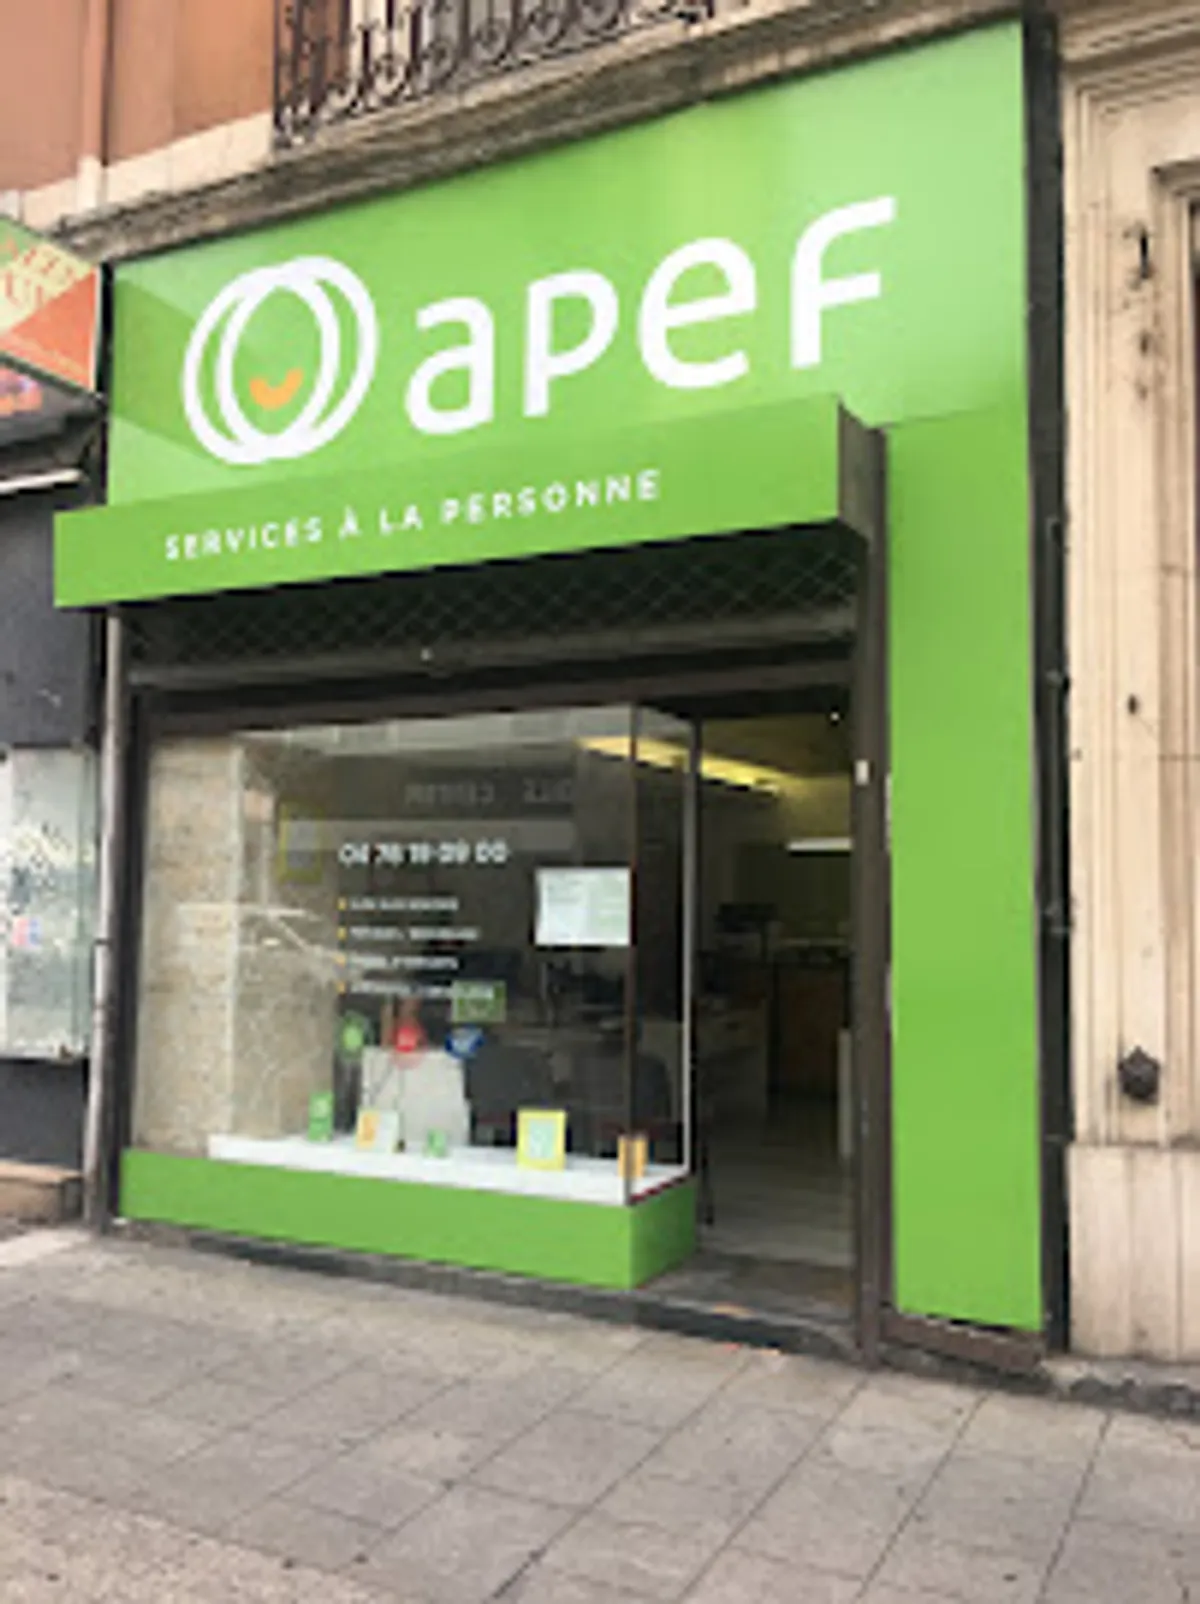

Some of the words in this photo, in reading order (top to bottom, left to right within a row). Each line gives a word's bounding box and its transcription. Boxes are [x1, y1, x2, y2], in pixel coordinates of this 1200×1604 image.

[165, 515, 323, 561] SERVICES
[339, 508, 361, 538] À
[379, 503, 424, 536] LA
[440, 469, 660, 526] PERSONNE
